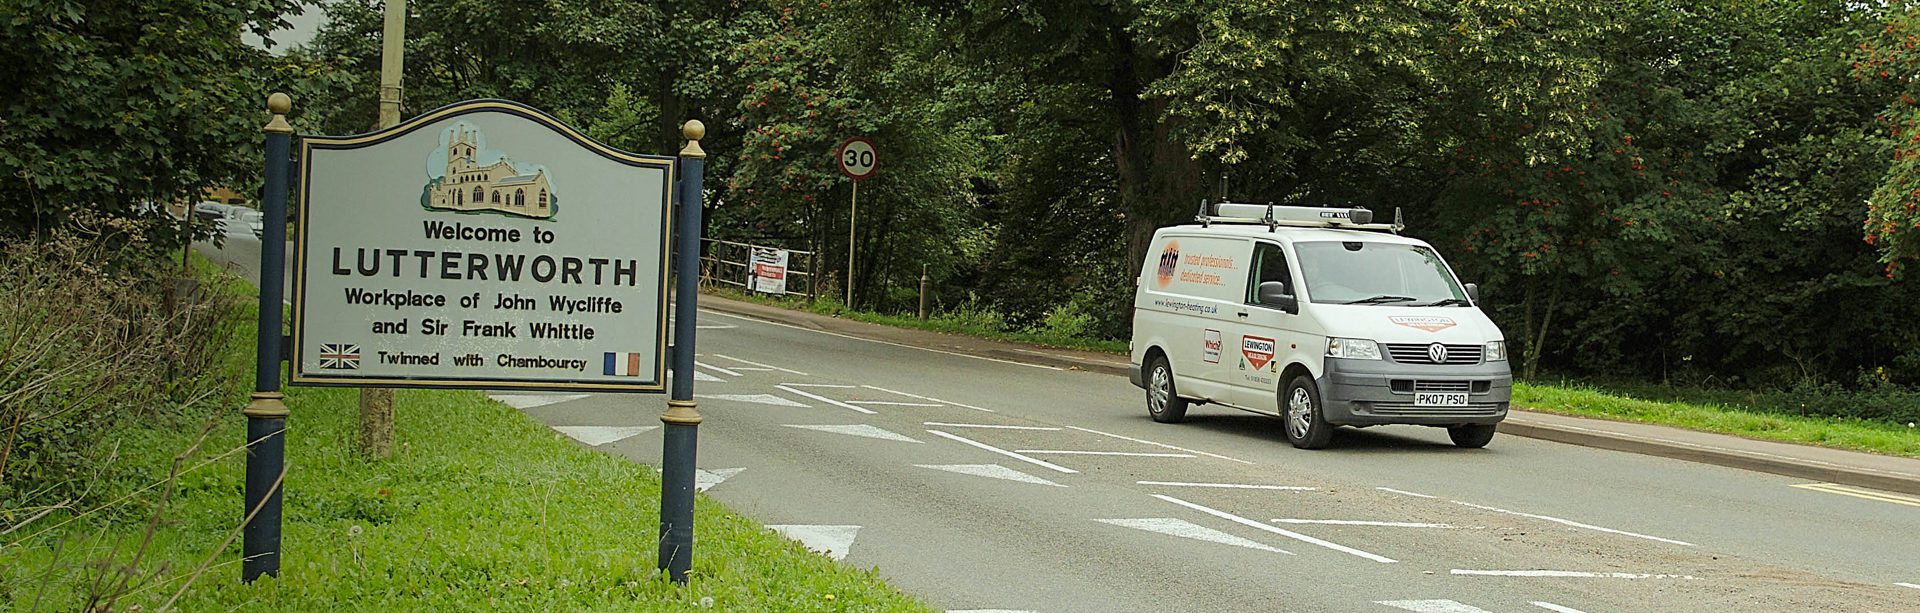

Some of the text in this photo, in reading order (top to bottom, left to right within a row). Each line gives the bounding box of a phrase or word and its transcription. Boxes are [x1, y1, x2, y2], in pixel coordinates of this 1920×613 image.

[844, 150, 874, 168] 30
[424, 221, 555, 244] Welcome to
[332, 247, 637, 287] LUTTERWORTH
[1184, 254, 1201, 266] trusted
[345, 288, 623, 315] Workplace of John Wycliffe
[1155, 299, 1217, 314] www.lewington-heating.co.uk
[372, 318, 595, 341] and Sir Frank Whittle
[1205, 339, 1221, 351] Which?
[1244, 340, 1272, 352] LEWINGTON
[378, 350, 588, 372] Twinned with Chambourcy
[1419, 394, 1445, 405] PK07
